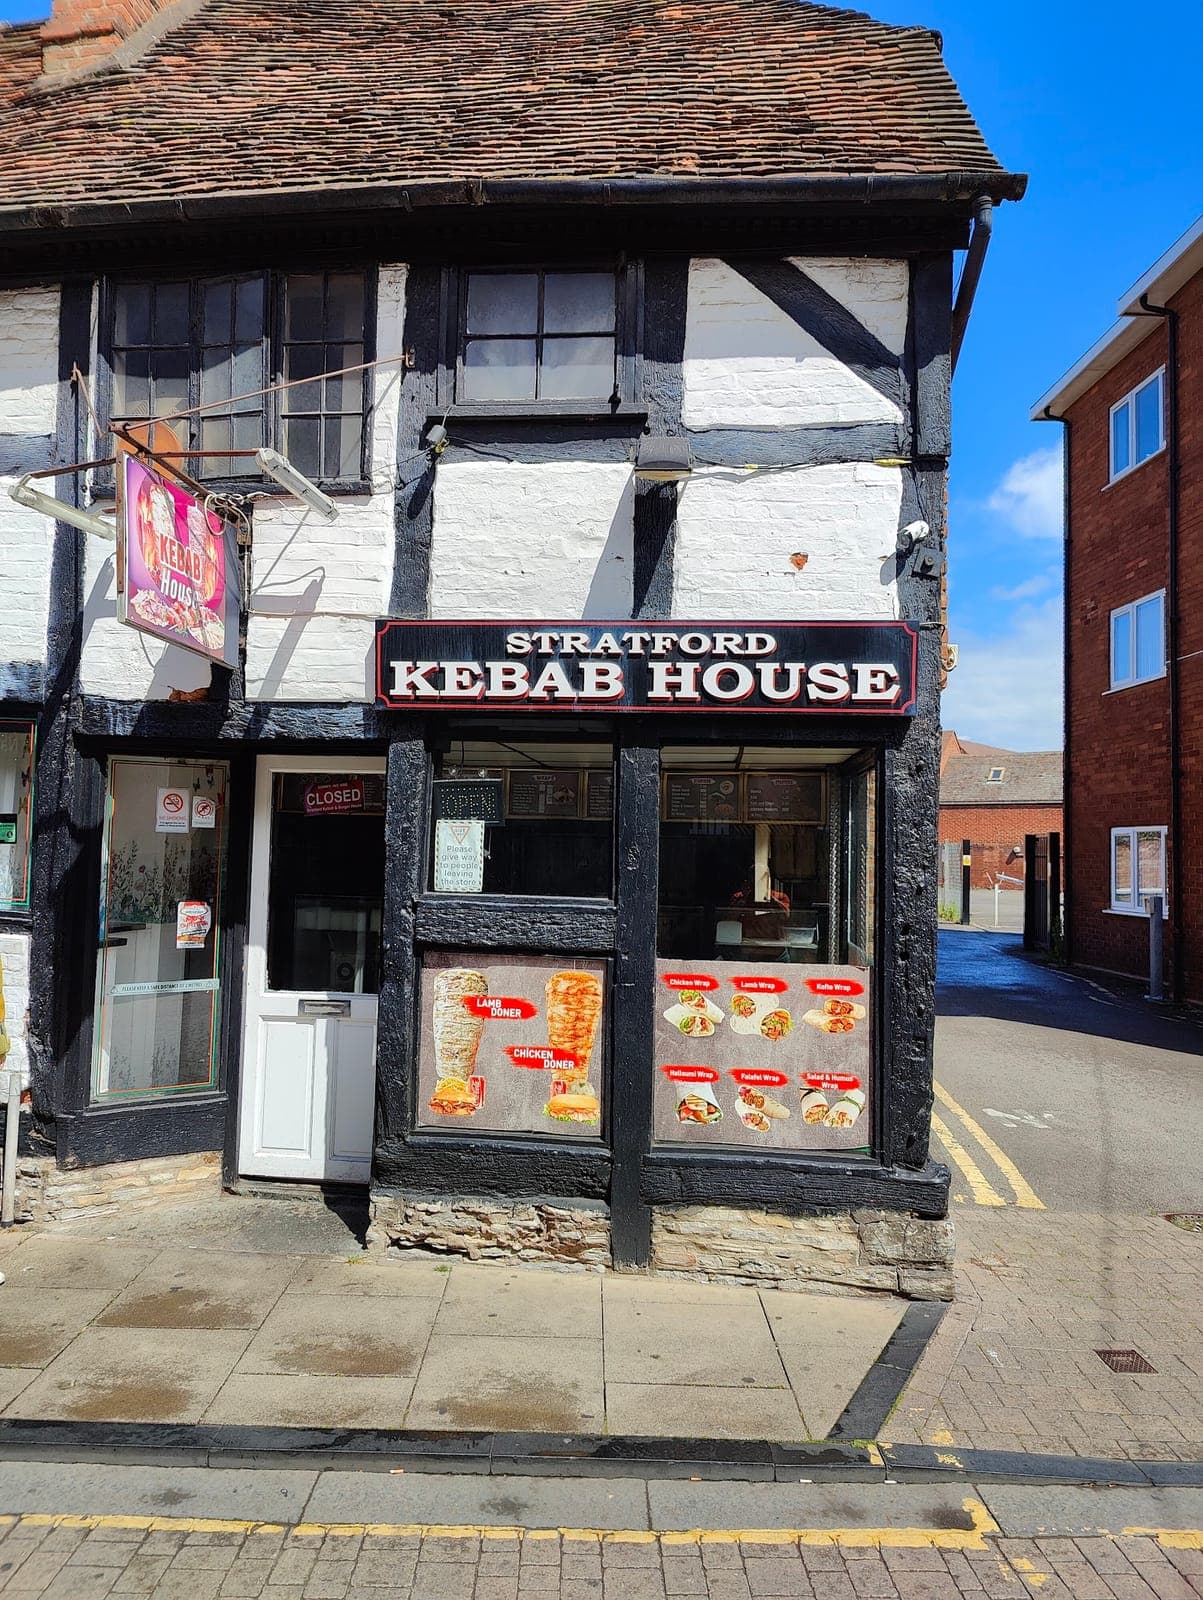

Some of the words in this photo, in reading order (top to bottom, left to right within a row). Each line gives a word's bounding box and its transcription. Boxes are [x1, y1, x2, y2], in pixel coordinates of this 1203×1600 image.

[159, 535, 202, 581] KEBAB
[506, 632, 778, 659] STRATFORD
[390, 661, 625, 702] KEBAB
[648, 662, 901, 703] HOUSE
[306, 789, 361, 806] CLOSED
[446, 794, 492, 816] OPEN
[446, 845, 473, 853] Please
[441, 854, 459, 862] give
[440, 861, 449, 869] to
[450, 861, 479, 871] people
[444, 870, 474, 878] leaving
[440, 878, 454, 886] the
[694, 980, 711, 988] Wrap
[758, 982, 776, 990] Wrap
[834, 984, 851, 992] Wrap
[476, 998, 502, 1008] LAMB
[491, 1007, 522, 1017] DONER
[543, 1060, 575, 1069] DONER
[697, 1070, 714, 1079] Wrap
[763, 1074, 780, 1082] Wrap
[821, 1081, 839, 1089] Wrap
